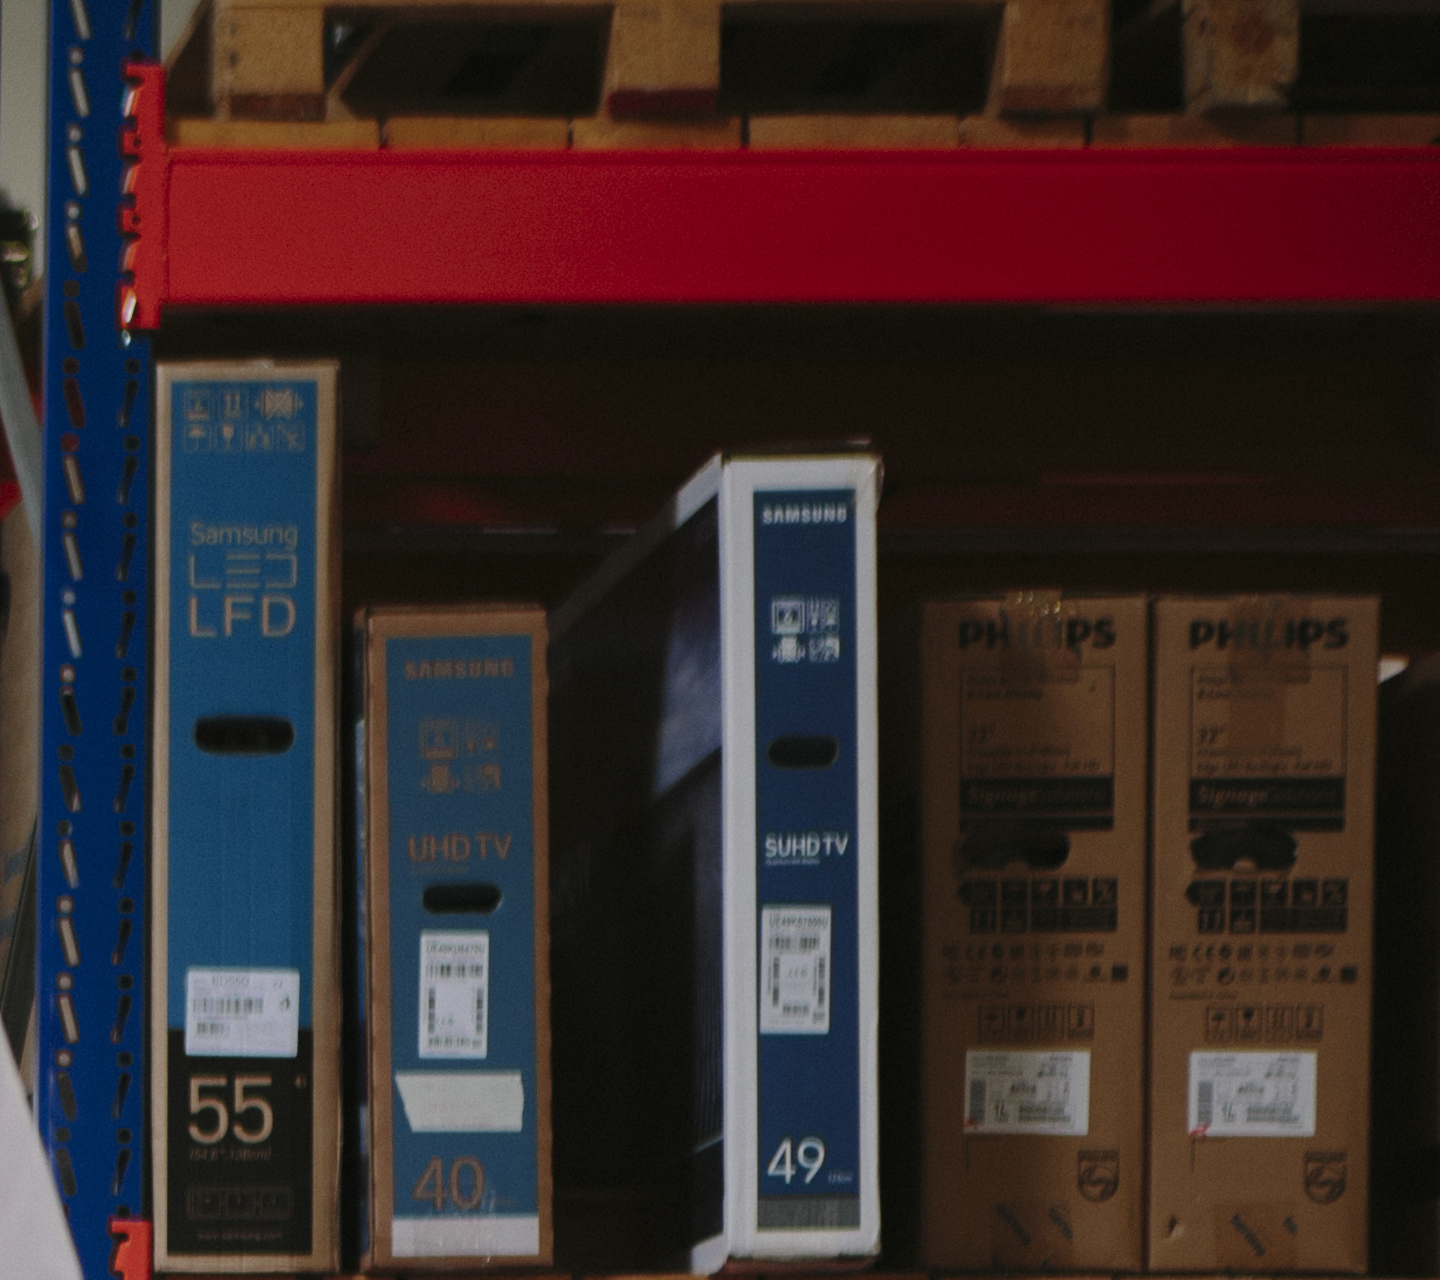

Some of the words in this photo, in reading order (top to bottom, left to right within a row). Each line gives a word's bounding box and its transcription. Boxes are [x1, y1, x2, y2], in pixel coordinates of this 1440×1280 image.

[762, 503, 848, 525] SAMSUNG
[189, 521, 298, 552] Samsung
[188, 595, 297, 637] LFD
[1189, 617, 1350, 650] PHILIPS
[404, 660, 515, 680] SAMSUNG
[406, 834, 471, 864] UHD
[474, 833, 513, 862] TV
[765, 832, 821, 858] SUHD
[822, 831, 849, 857] TV
[186, 1073, 274, 1144] 55
[767, 1135, 826, 1185] 49
[412, 1155, 487, 1210] 40
